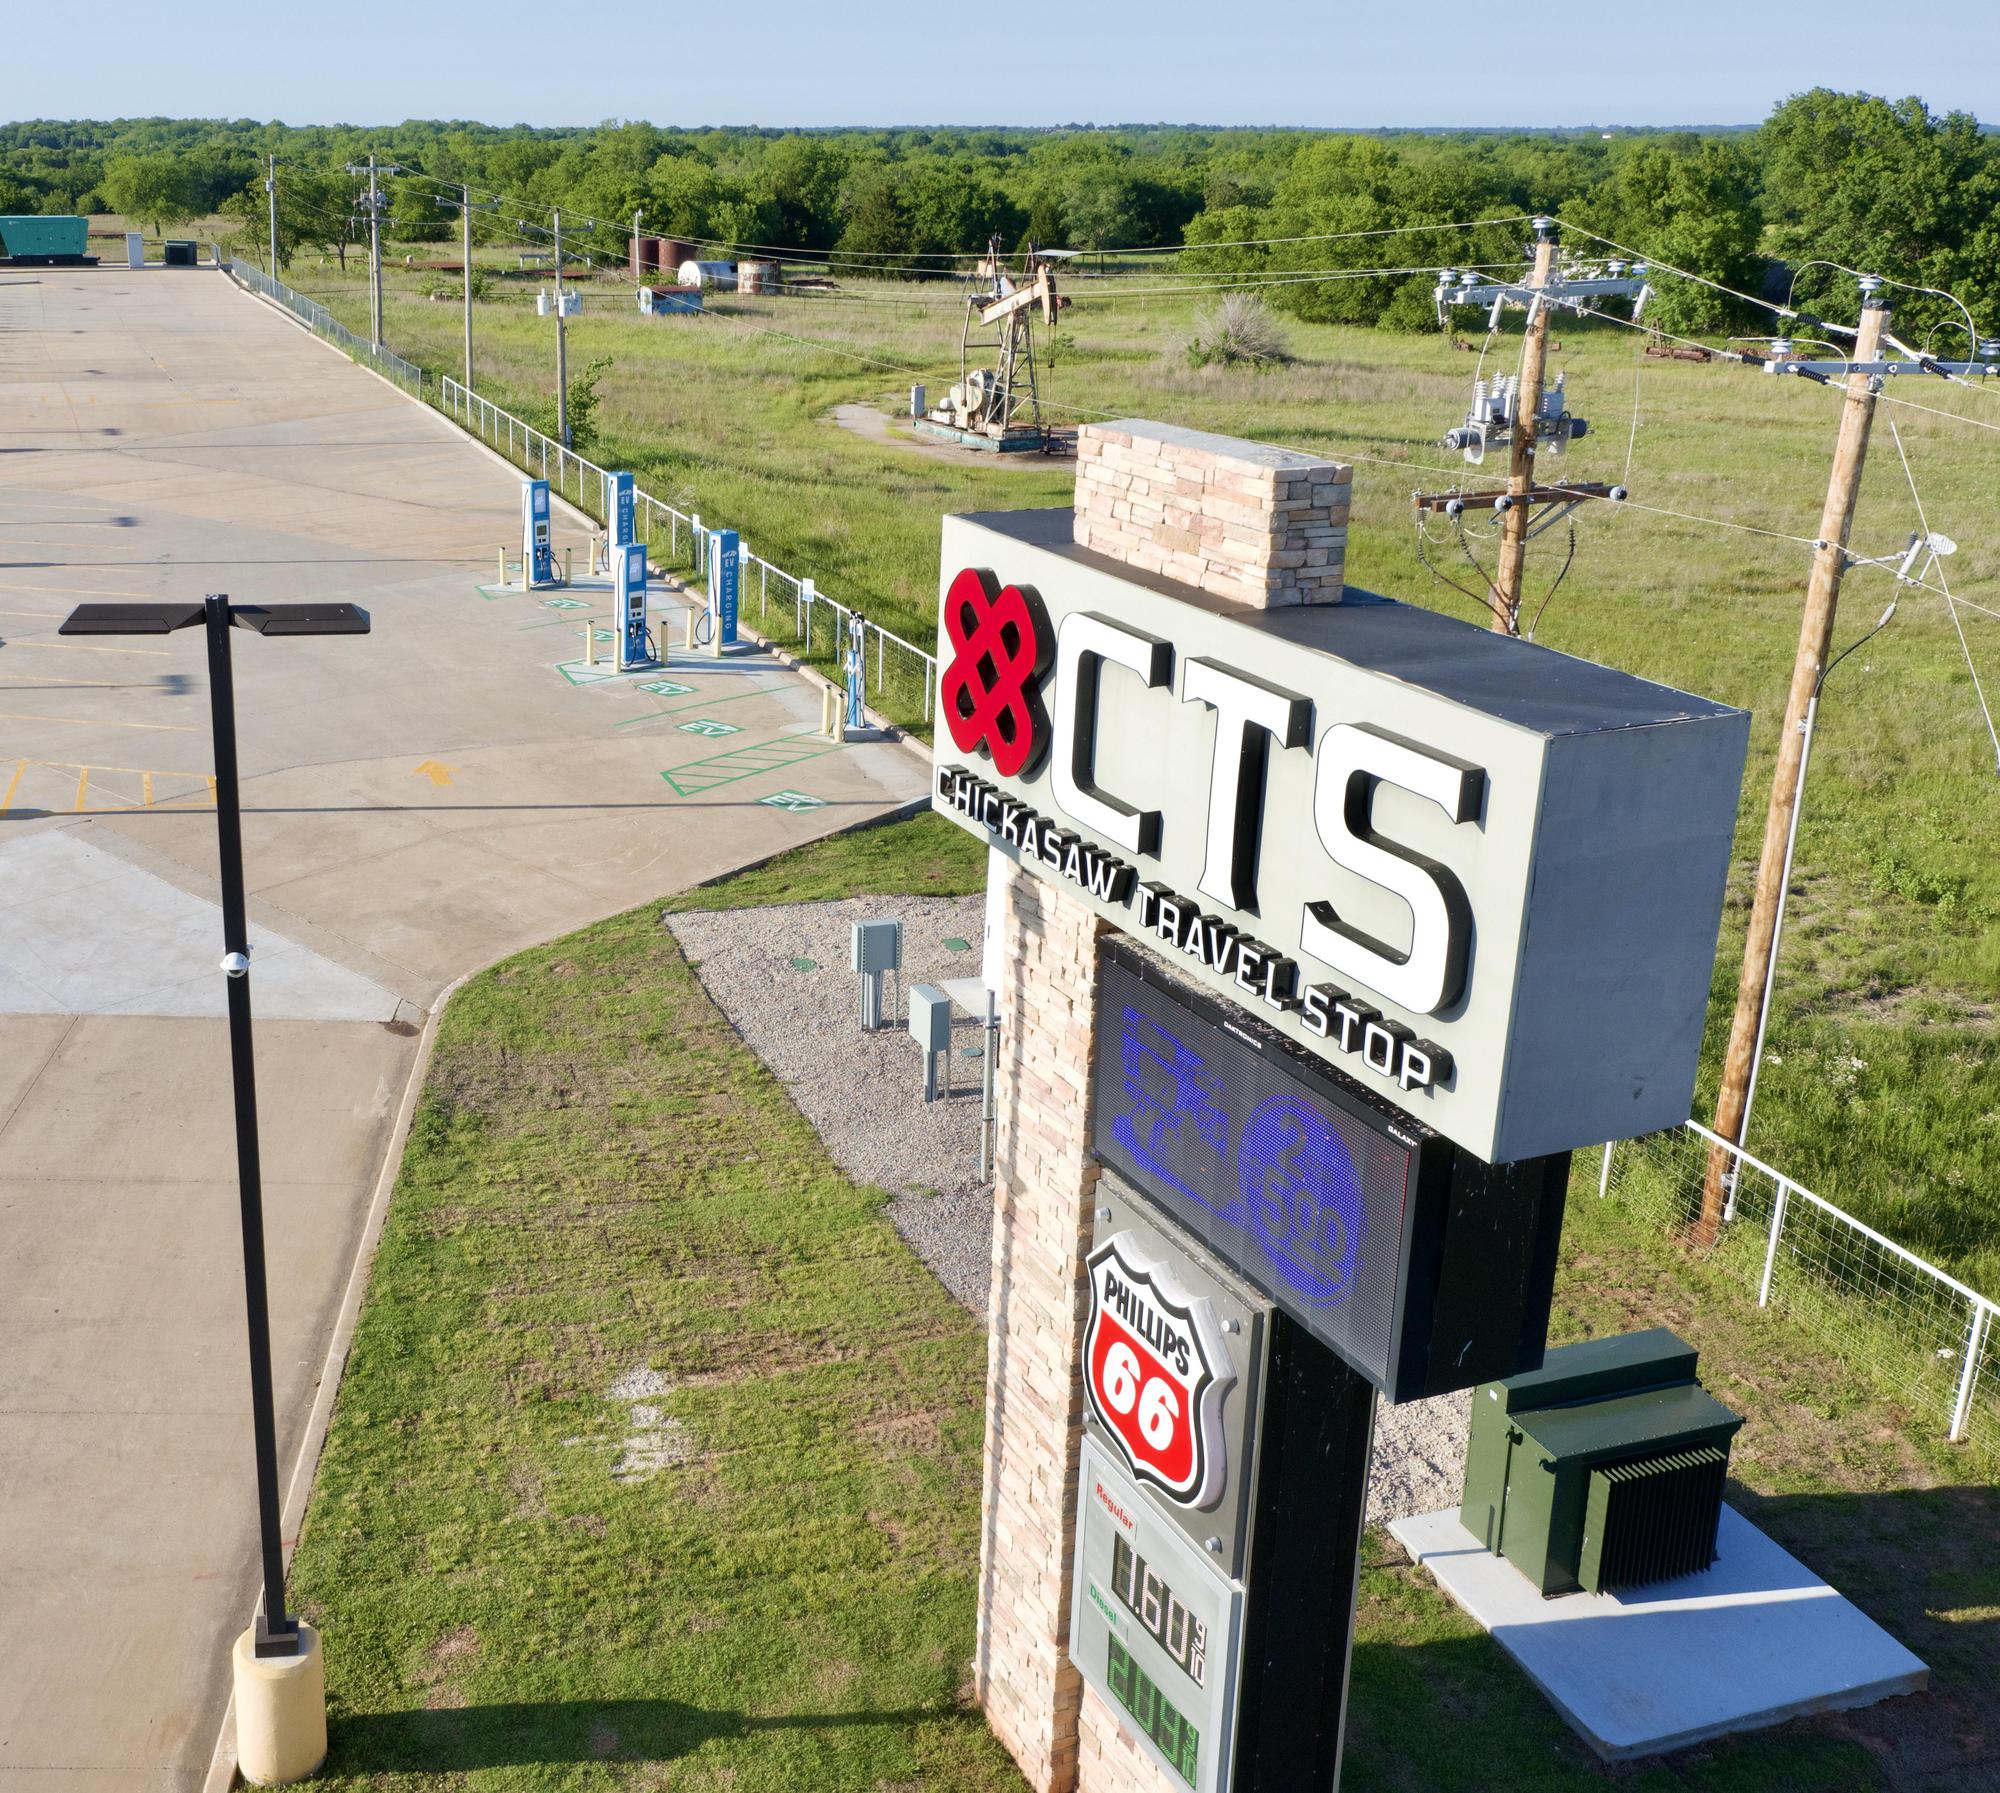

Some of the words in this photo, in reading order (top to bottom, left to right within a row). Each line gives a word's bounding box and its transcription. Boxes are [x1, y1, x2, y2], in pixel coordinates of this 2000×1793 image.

[724, 571, 733, 630] CHARGING
[1050, 611, 1478, 1015] CTS
[936, 765, 1128, 903] CHICKASAW
[1136, 881, 1294, 1007] TRAVEL
[1300, 984, 1440, 1090] STOP
[1223, 1020, 1262, 1049] DAKTRONICS
[1276, 1112, 1307, 1180] 2
[1387, 1124, 1418, 1147] GALAXY
[1103, 1268, 1190, 1377] PHILLIPS
[1102, 1341, 1180, 1451] 66
[1096, 1482, 1134, 1531] Regular
[1089, 1582, 1117, 1626] Diesel
